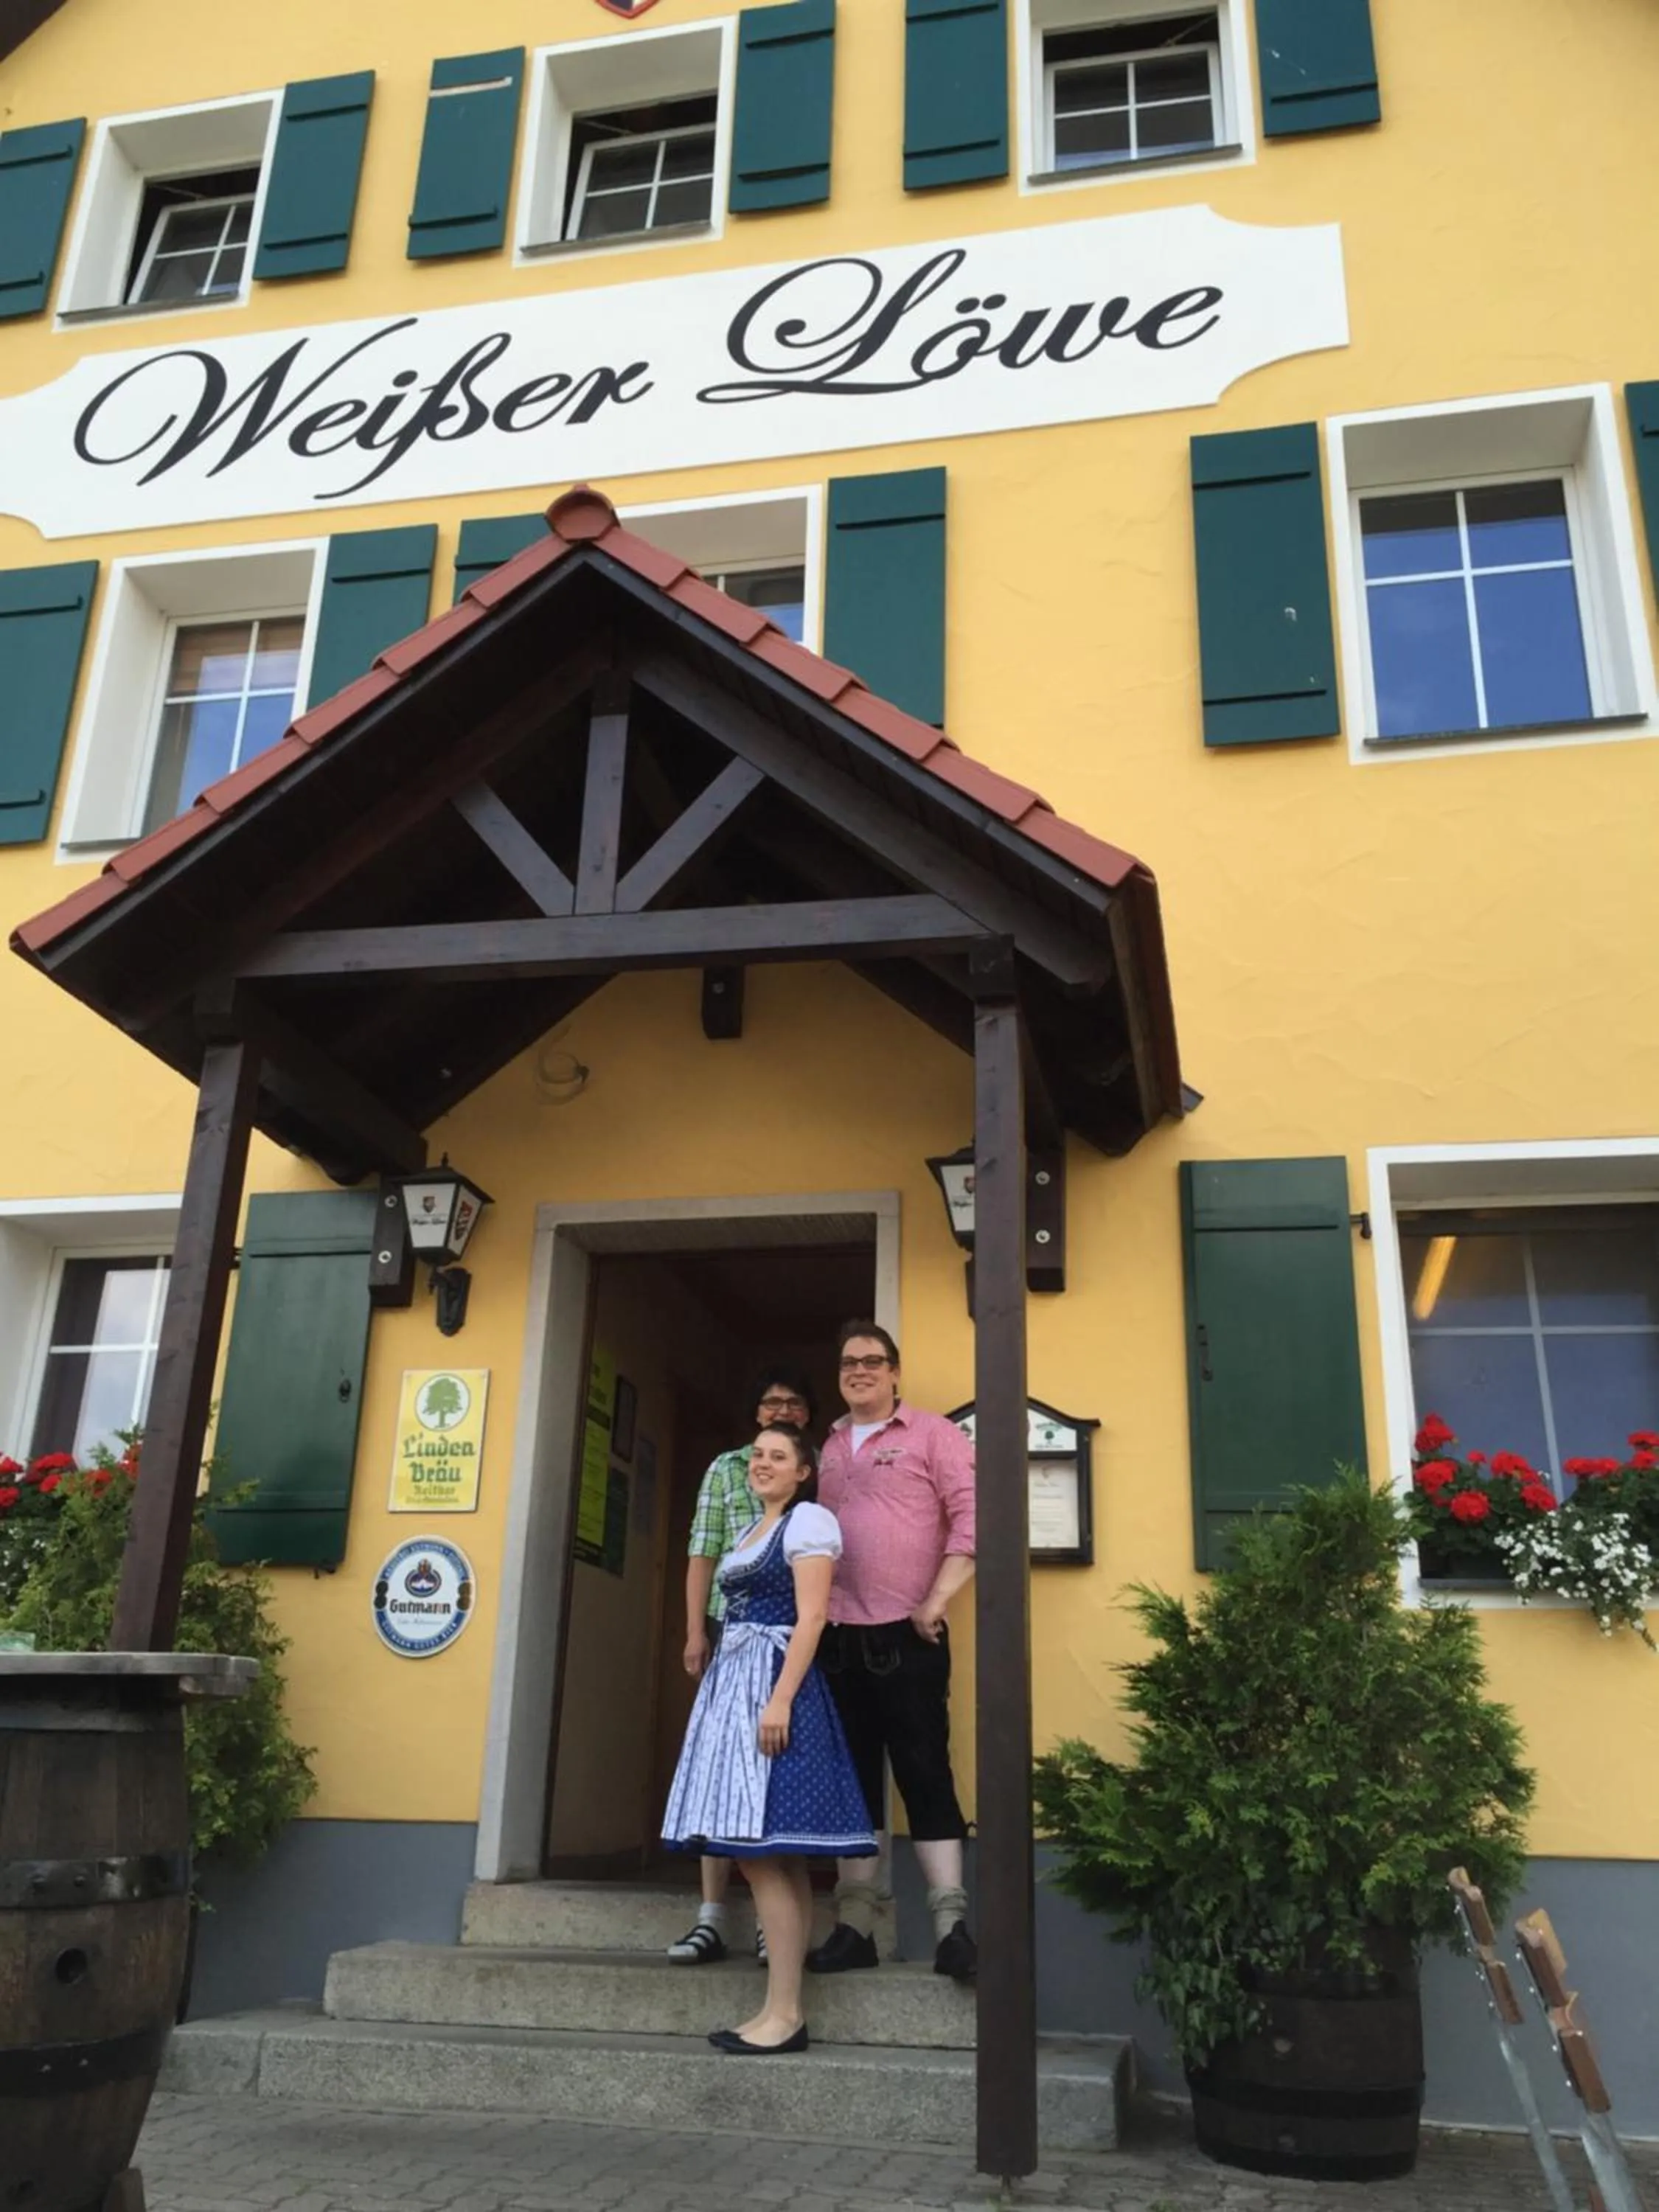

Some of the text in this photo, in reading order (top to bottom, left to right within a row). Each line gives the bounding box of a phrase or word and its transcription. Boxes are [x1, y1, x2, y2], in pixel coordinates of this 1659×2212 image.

[74, 250, 1222, 498] Weißer Löwe
[403, 1432, 475, 1458] Linden
[408, 1460, 461, 1482] Bräu
[389, 1599, 451, 1614] Gutmann
